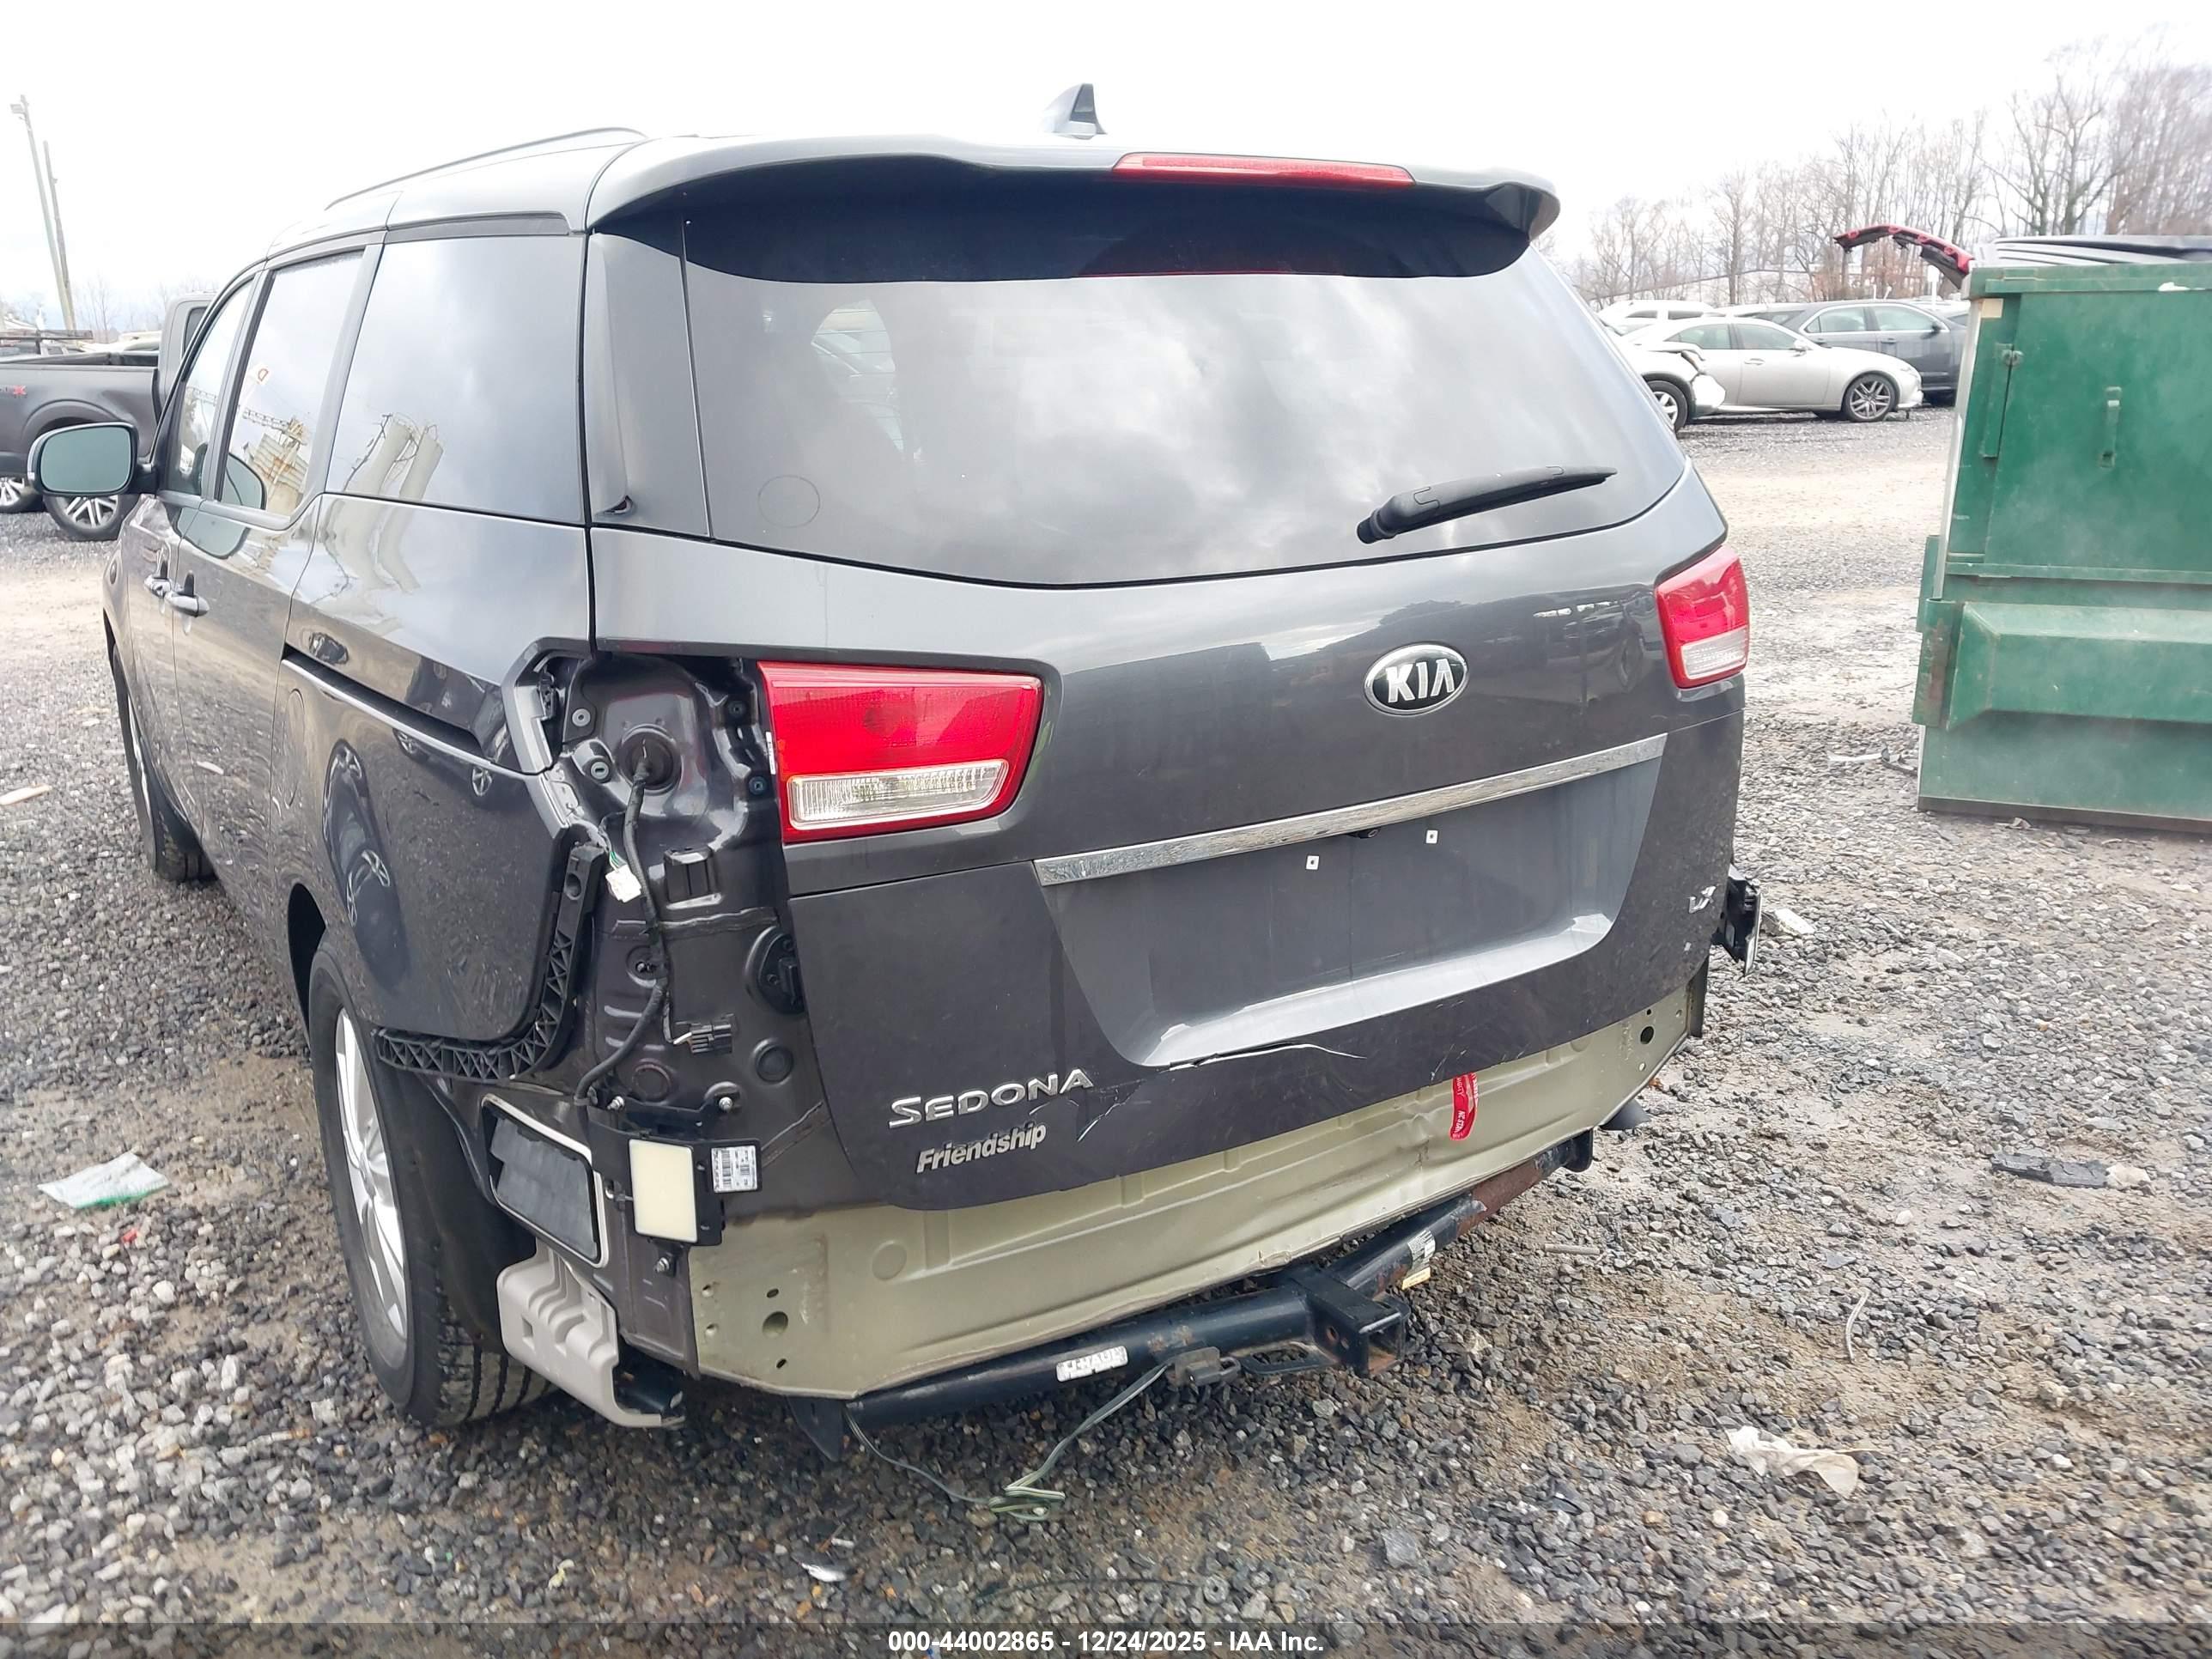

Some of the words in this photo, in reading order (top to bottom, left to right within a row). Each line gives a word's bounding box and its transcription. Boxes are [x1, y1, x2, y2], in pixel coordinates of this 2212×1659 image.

[1385, 658, 1455, 703] KIA
[889, 1068, 1094, 1129] SEDONA
[915, 1122, 1047, 1175] Friendship
